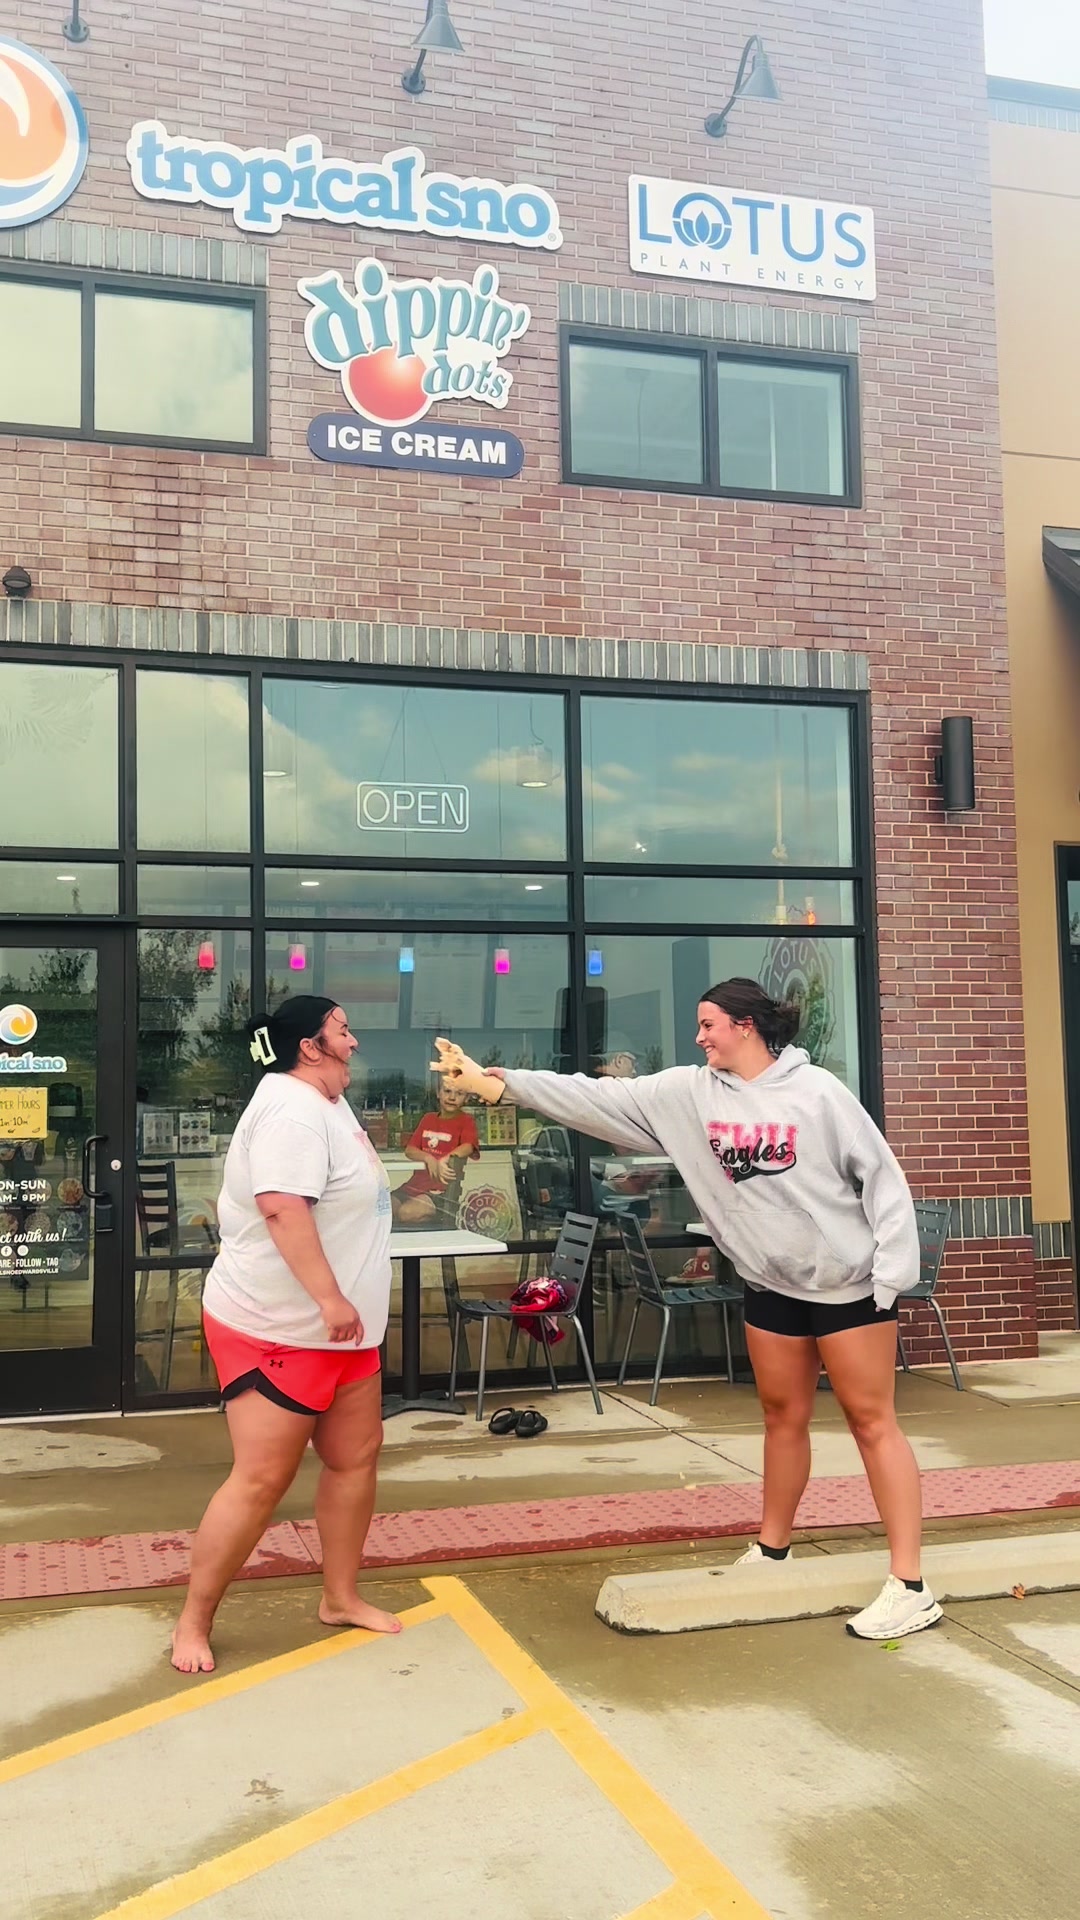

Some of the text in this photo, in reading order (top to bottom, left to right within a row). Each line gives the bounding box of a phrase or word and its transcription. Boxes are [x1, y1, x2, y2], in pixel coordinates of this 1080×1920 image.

[136, 129, 552, 238] tropical sno
[637, 183, 867, 269] LOTUS
[640, 252, 865, 292] PLANT ENERGY
[303, 263, 526, 364] dippin'
[425, 352, 509, 400] dots
[327, 424, 508, 465] ICE CREAM
[362, 788, 464, 825] OPEN
[774, 941, 817, 983] LOTUS
[0, 1053, 32, 1071] ical
[13, 1228, 44, 1243] with
[15, 1257, 42, 1268] FOLLOW
